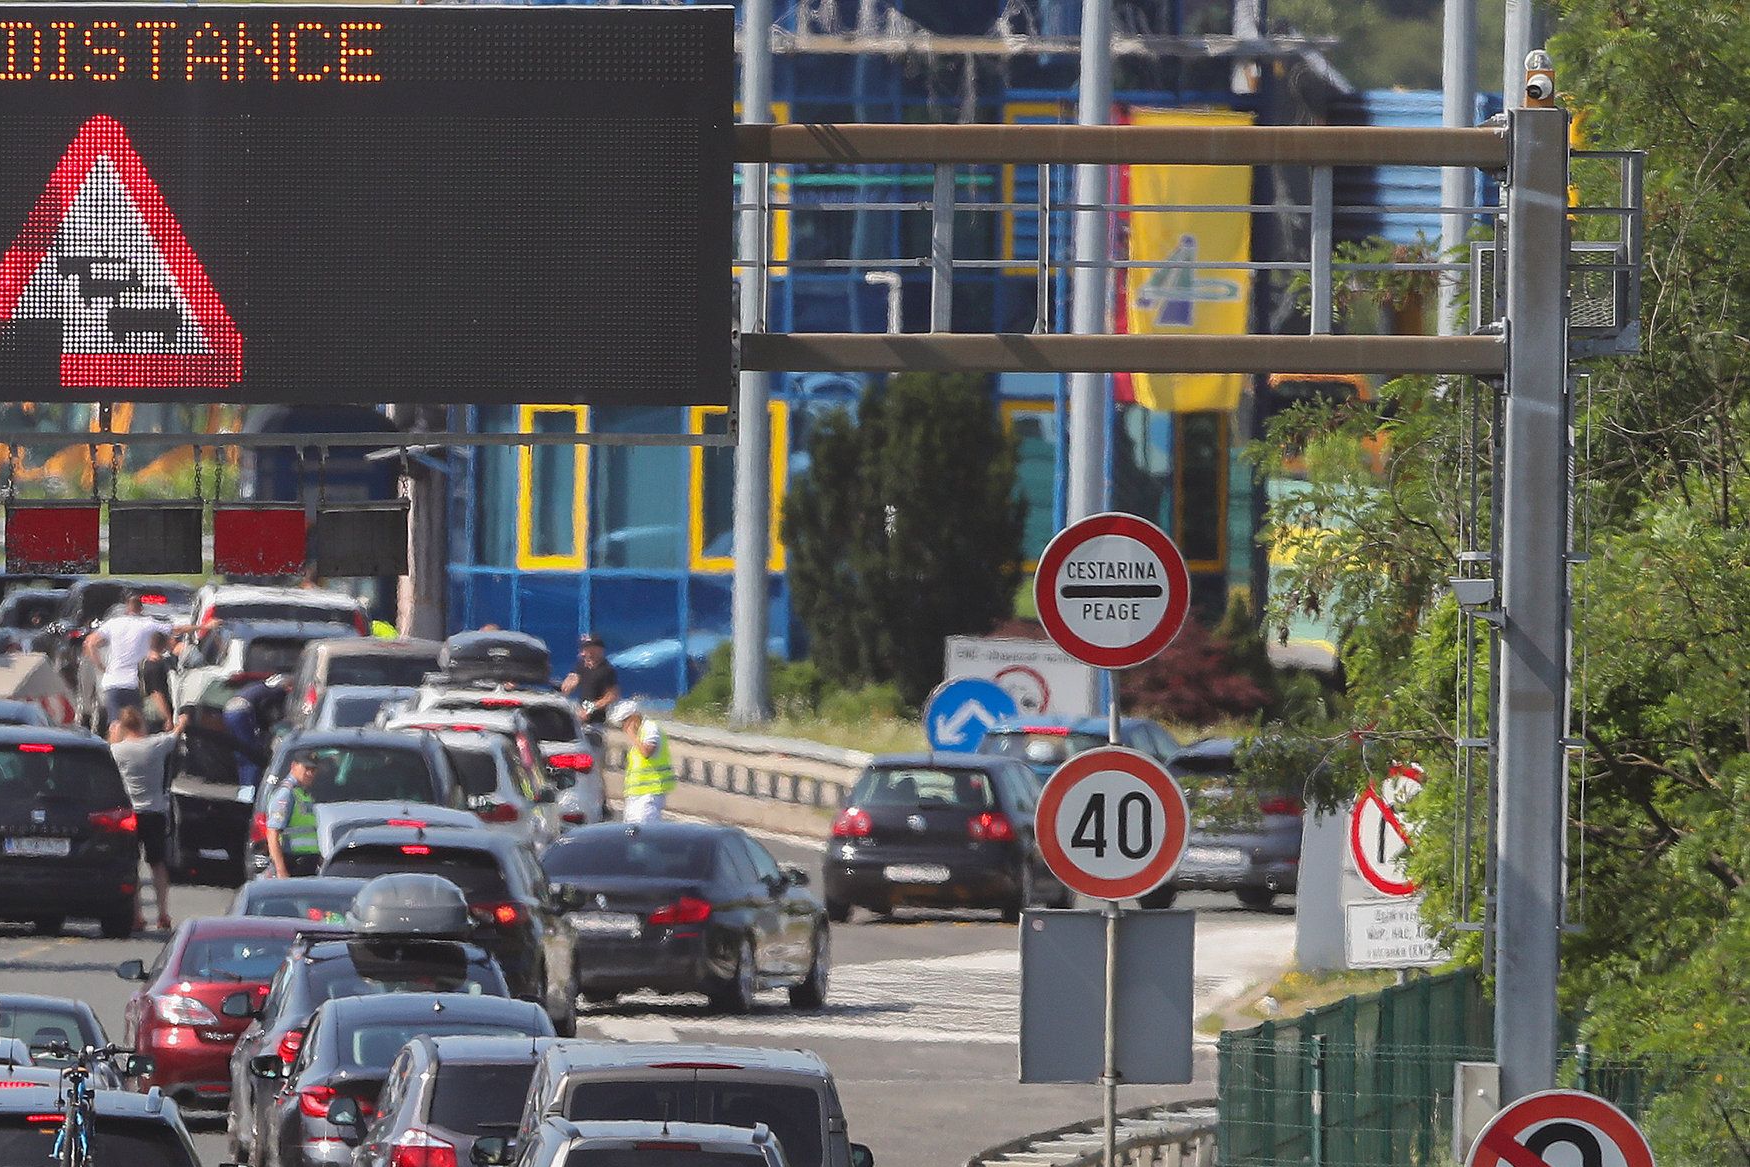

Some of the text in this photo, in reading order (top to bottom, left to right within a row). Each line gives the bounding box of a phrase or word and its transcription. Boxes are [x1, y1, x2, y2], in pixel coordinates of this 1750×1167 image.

[1067, 561, 1157, 580] CESTARINA
[1082, 603, 1141, 621] PEAGE
[1071, 791, 1152, 859] 40
